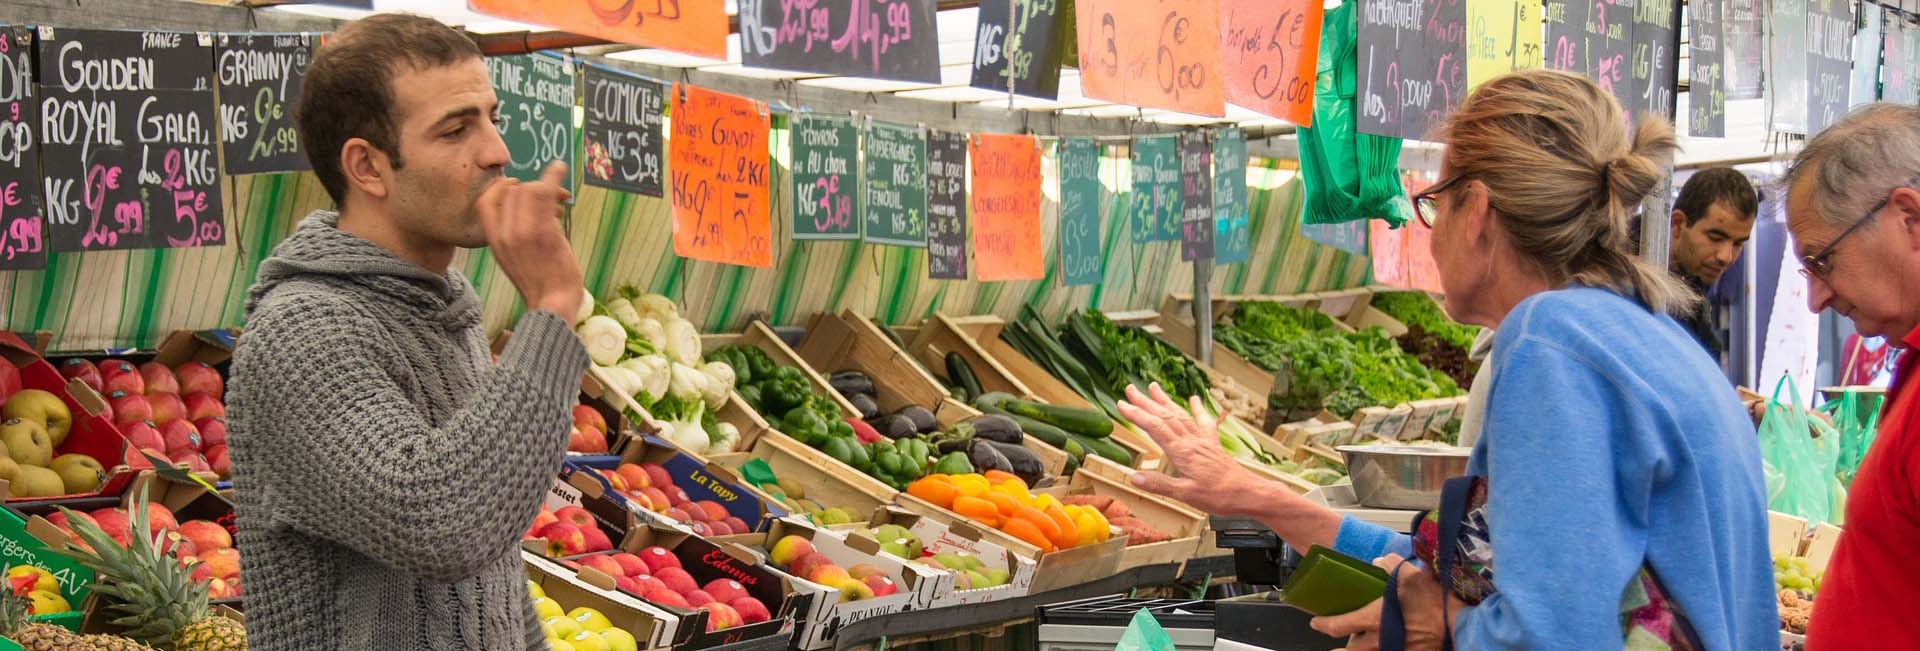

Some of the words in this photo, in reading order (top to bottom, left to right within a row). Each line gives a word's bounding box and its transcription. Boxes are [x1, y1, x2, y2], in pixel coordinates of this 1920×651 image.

[142, 32, 182, 50] FRANCE
[975, 22, 1002, 70] KG
[219, 49, 292, 102] GRANNY
[594, 78, 649, 130] COMICE
[42, 96, 125, 163] ROYAL
[220, 103, 248, 143] KG
[608, 128, 625, 160] KG
[892, 162, 910, 188] KG
[45, 176, 80, 225] KG
[797, 182, 817, 217] KG
[891, 212, 906, 235] KG
[689, 469, 709, 486] La
[707, 479, 739, 503] Tapy
